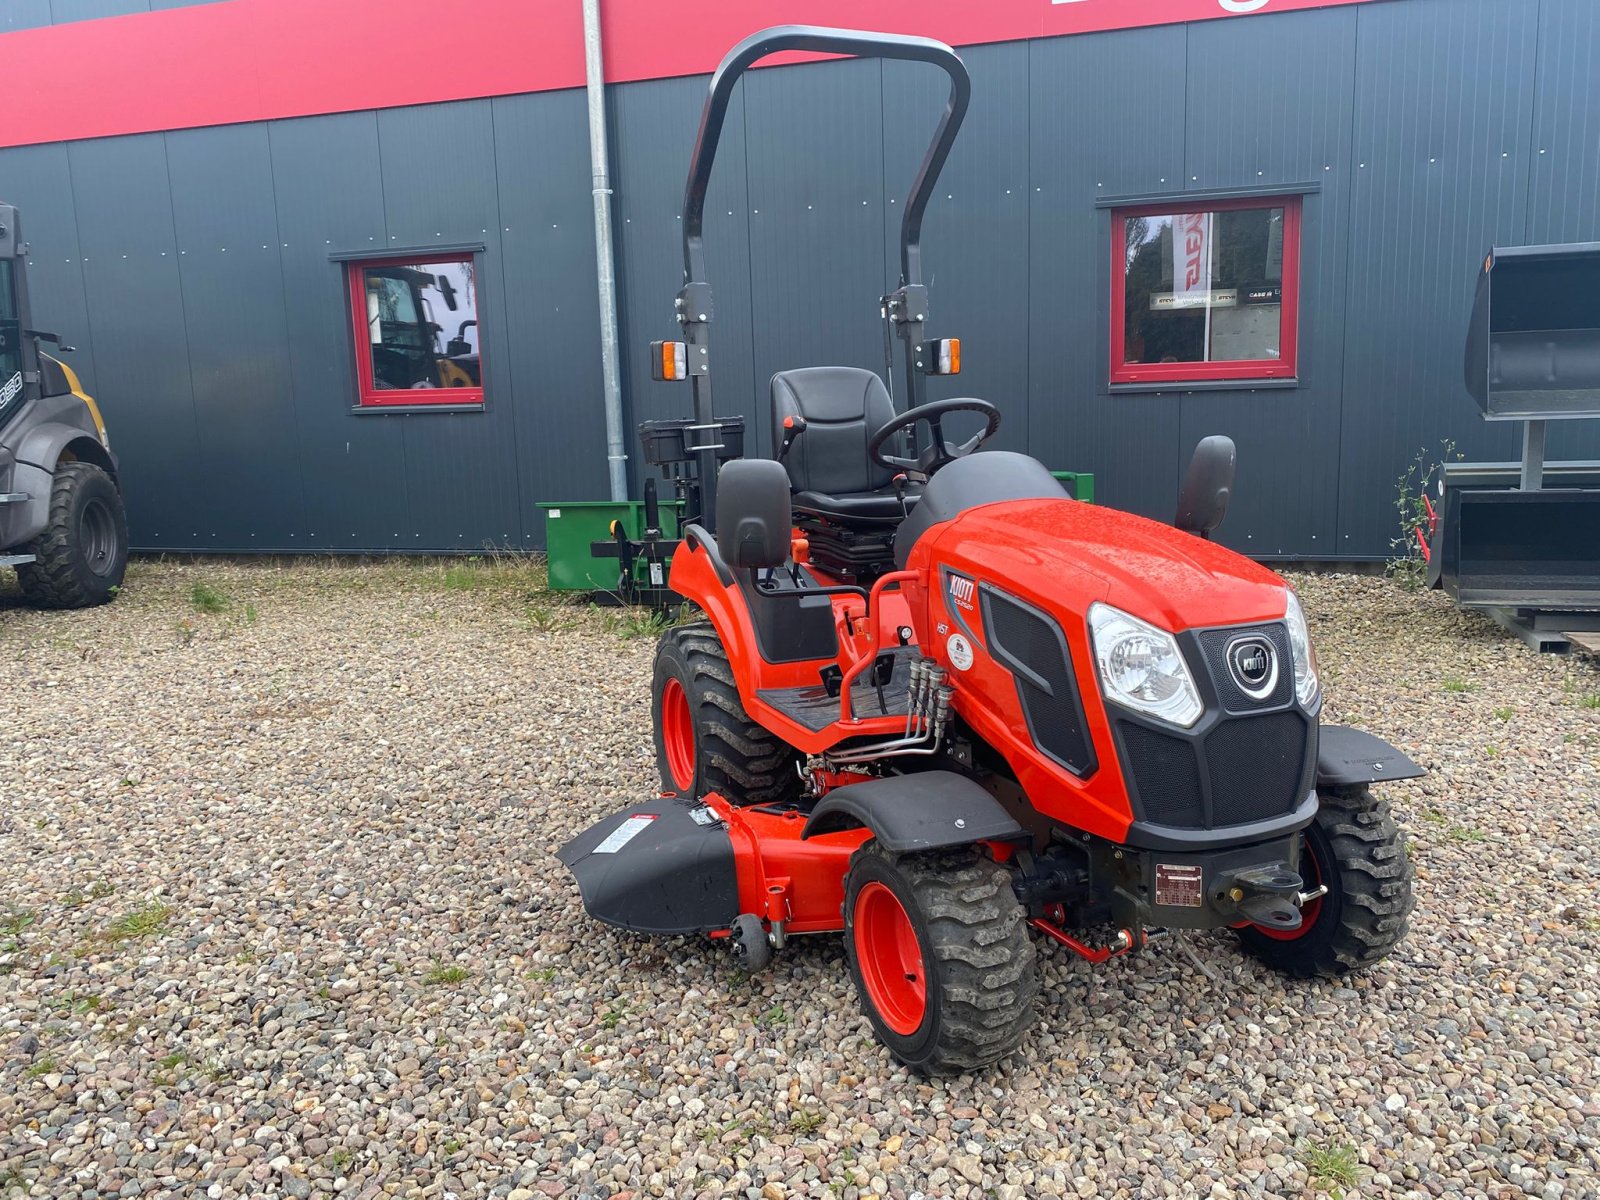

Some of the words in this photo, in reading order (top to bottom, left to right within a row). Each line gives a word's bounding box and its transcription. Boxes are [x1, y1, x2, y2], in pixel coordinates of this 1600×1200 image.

[950, 575, 974, 602] KIOTI
[937, 622, 949, 635] HST
[1243, 657, 1264, 671] KIOTI
